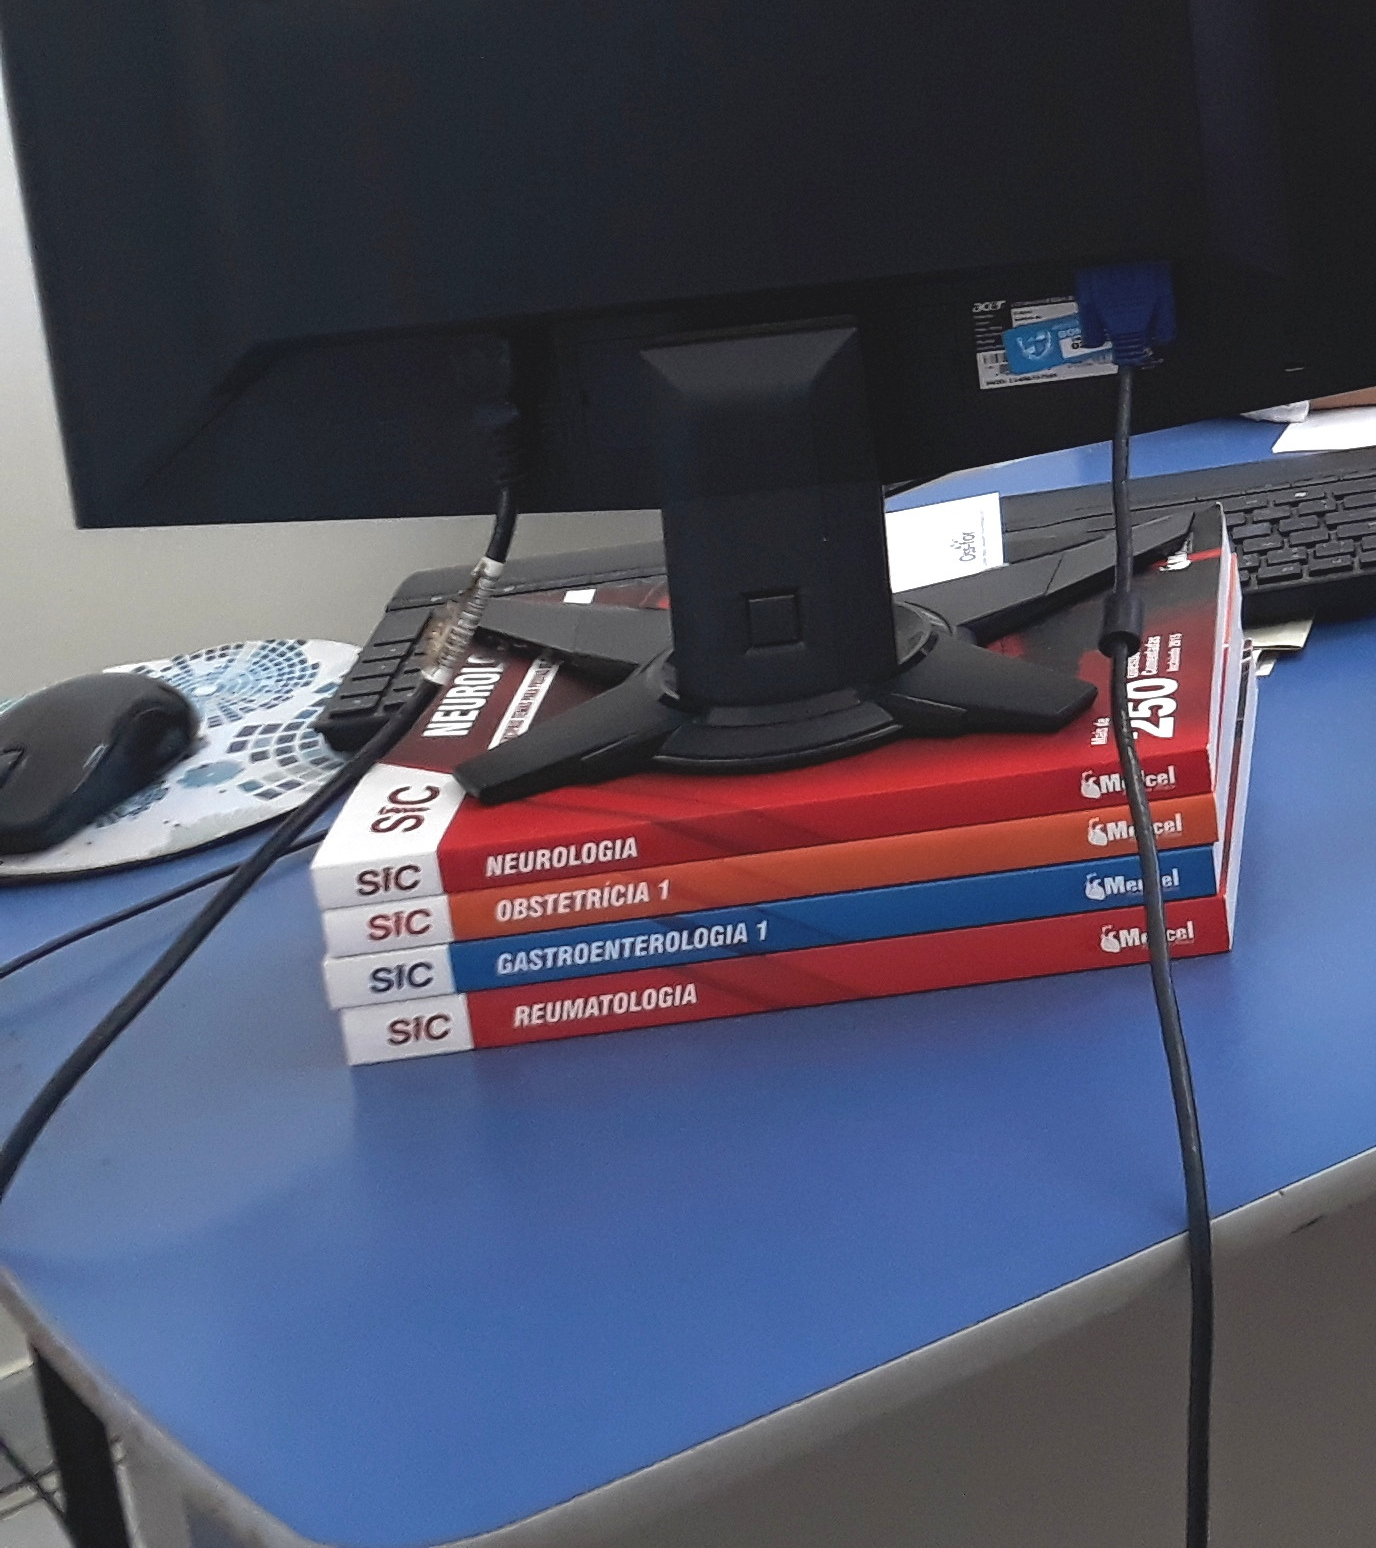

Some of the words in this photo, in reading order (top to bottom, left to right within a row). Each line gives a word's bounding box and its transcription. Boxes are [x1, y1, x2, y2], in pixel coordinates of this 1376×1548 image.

[972, 300, 1007, 313] acer
[1126, 677, 1180, 739] 250
[484, 836, 638, 878] NEUROLOGIA
[495, 880, 650, 923] OBSTETRÍCIA
[657, 878, 671, 901] 1
[496, 923, 749, 975] GASTROENTEROLOGIA
[755, 919, 770, 941] 1
[513, 982, 699, 1029] REUMATOLOGIA
